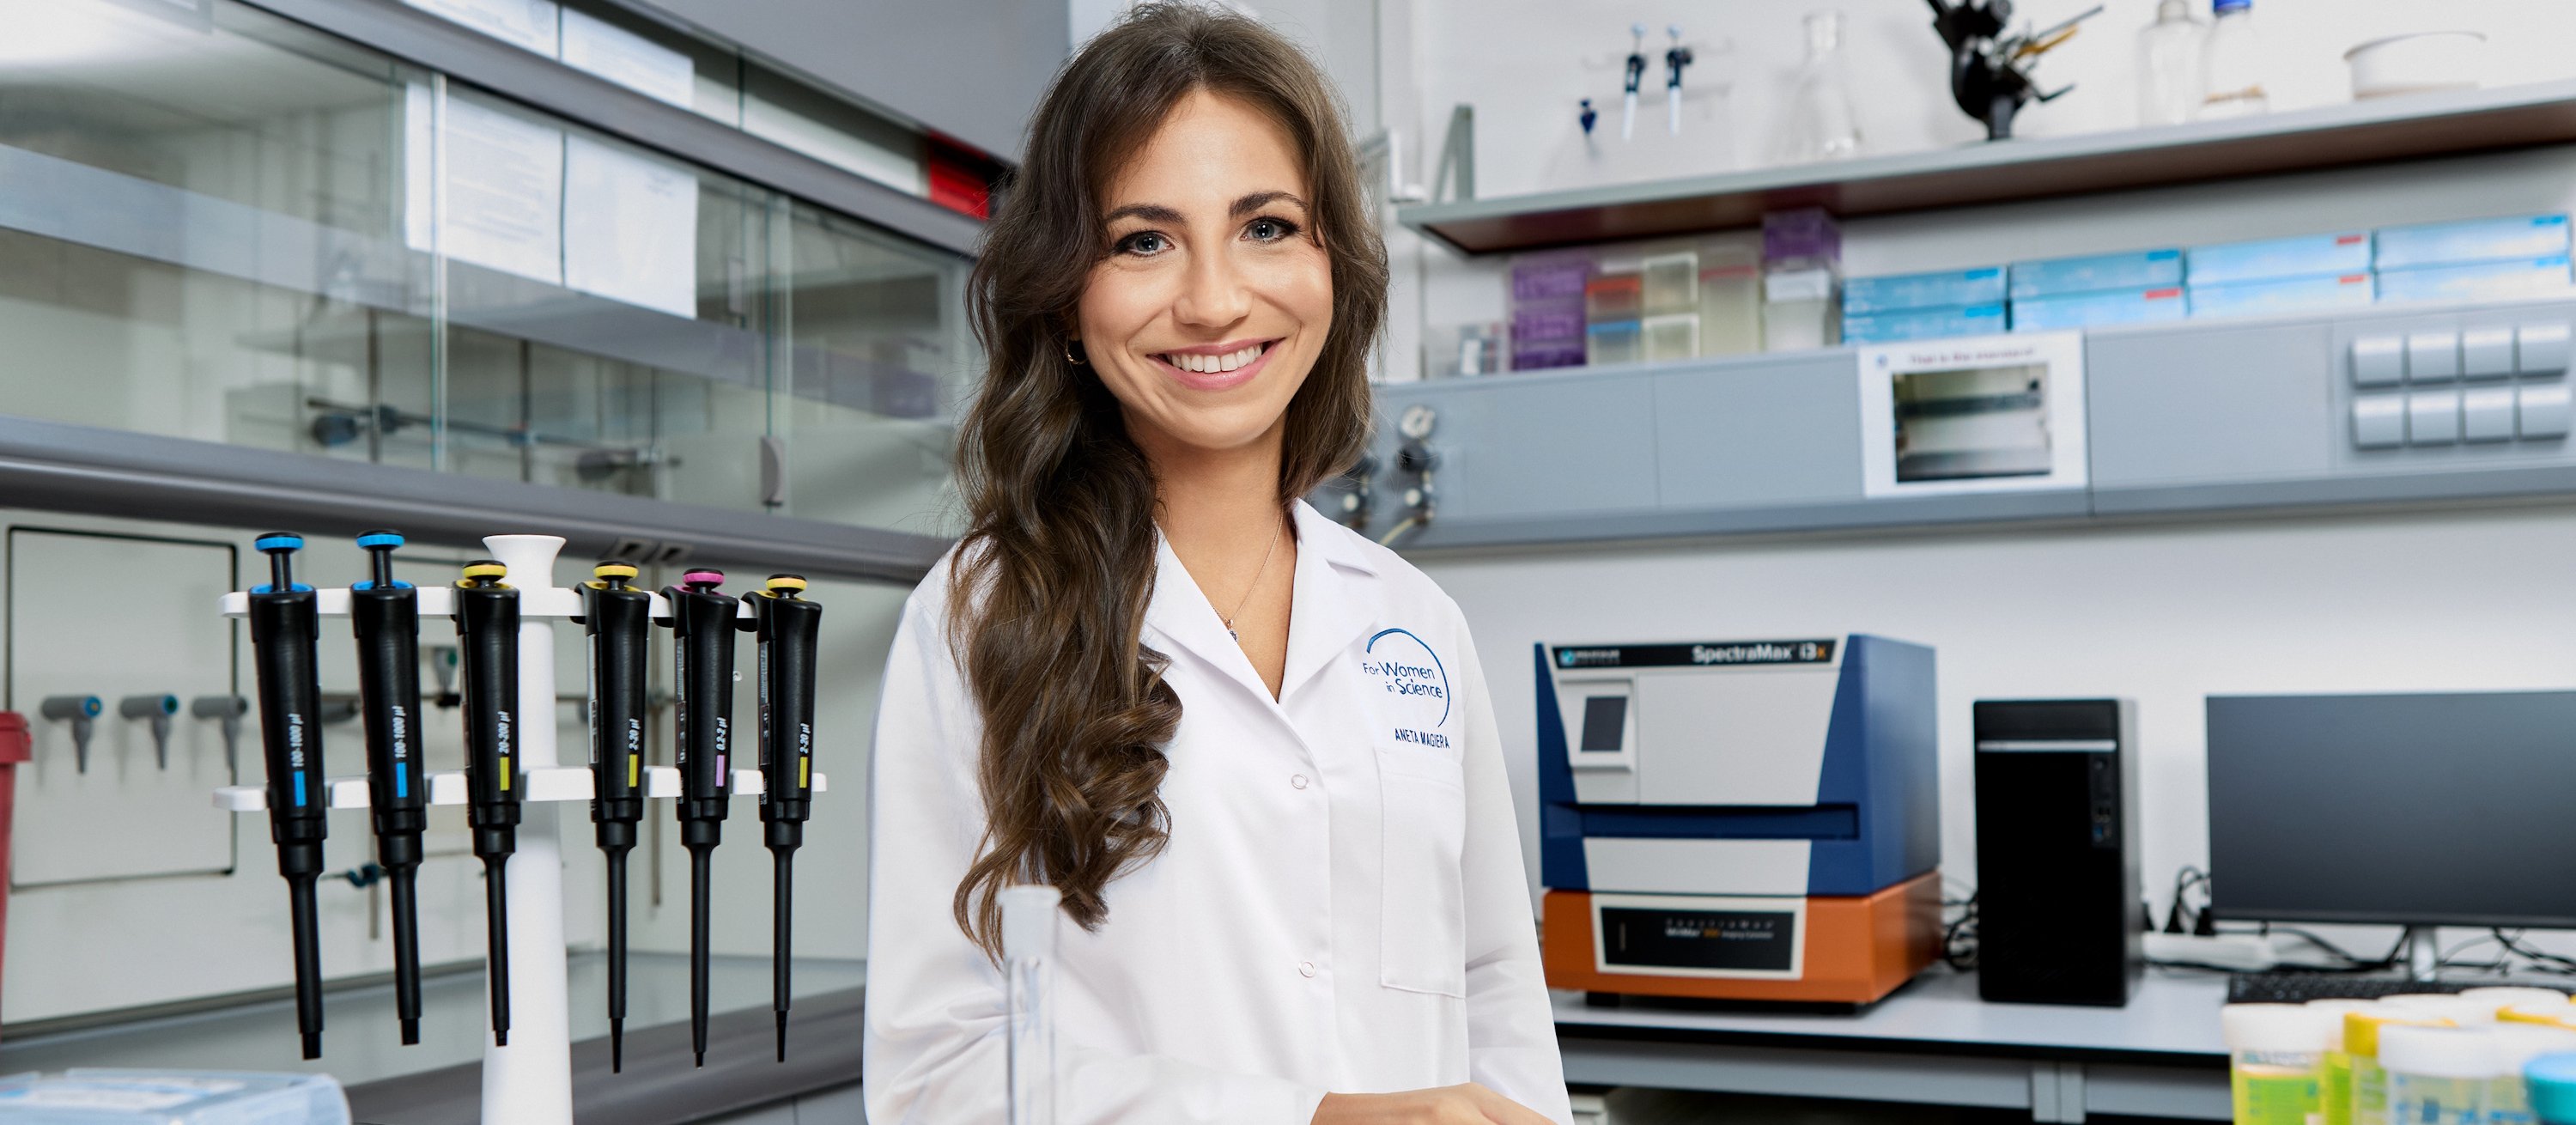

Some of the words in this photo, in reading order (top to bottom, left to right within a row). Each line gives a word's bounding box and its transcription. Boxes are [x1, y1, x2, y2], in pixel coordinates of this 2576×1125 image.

[1692, 644, 1793, 664] SpectraMax
[1799, 642, 1826, 660] i3x
[1363, 662, 1380, 676] For
[1378, 662, 1436, 679] Women
[1386, 681, 1394, 693] in
[1395, 678, 1443, 698] Science
[289, 725, 305, 767] 100-1000
[392, 717, 407, 758] 100-1000
[497, 722, 510, 754] 20-200
[629, 729, 640, 751] 2-20
[715, 727, 727, 751] 0.2-2
[799, 733, 810, 754] 2-20
[1395, 728, 1419, 745] ANETA
[1420, 731, 1449, 749] MAGIERA
